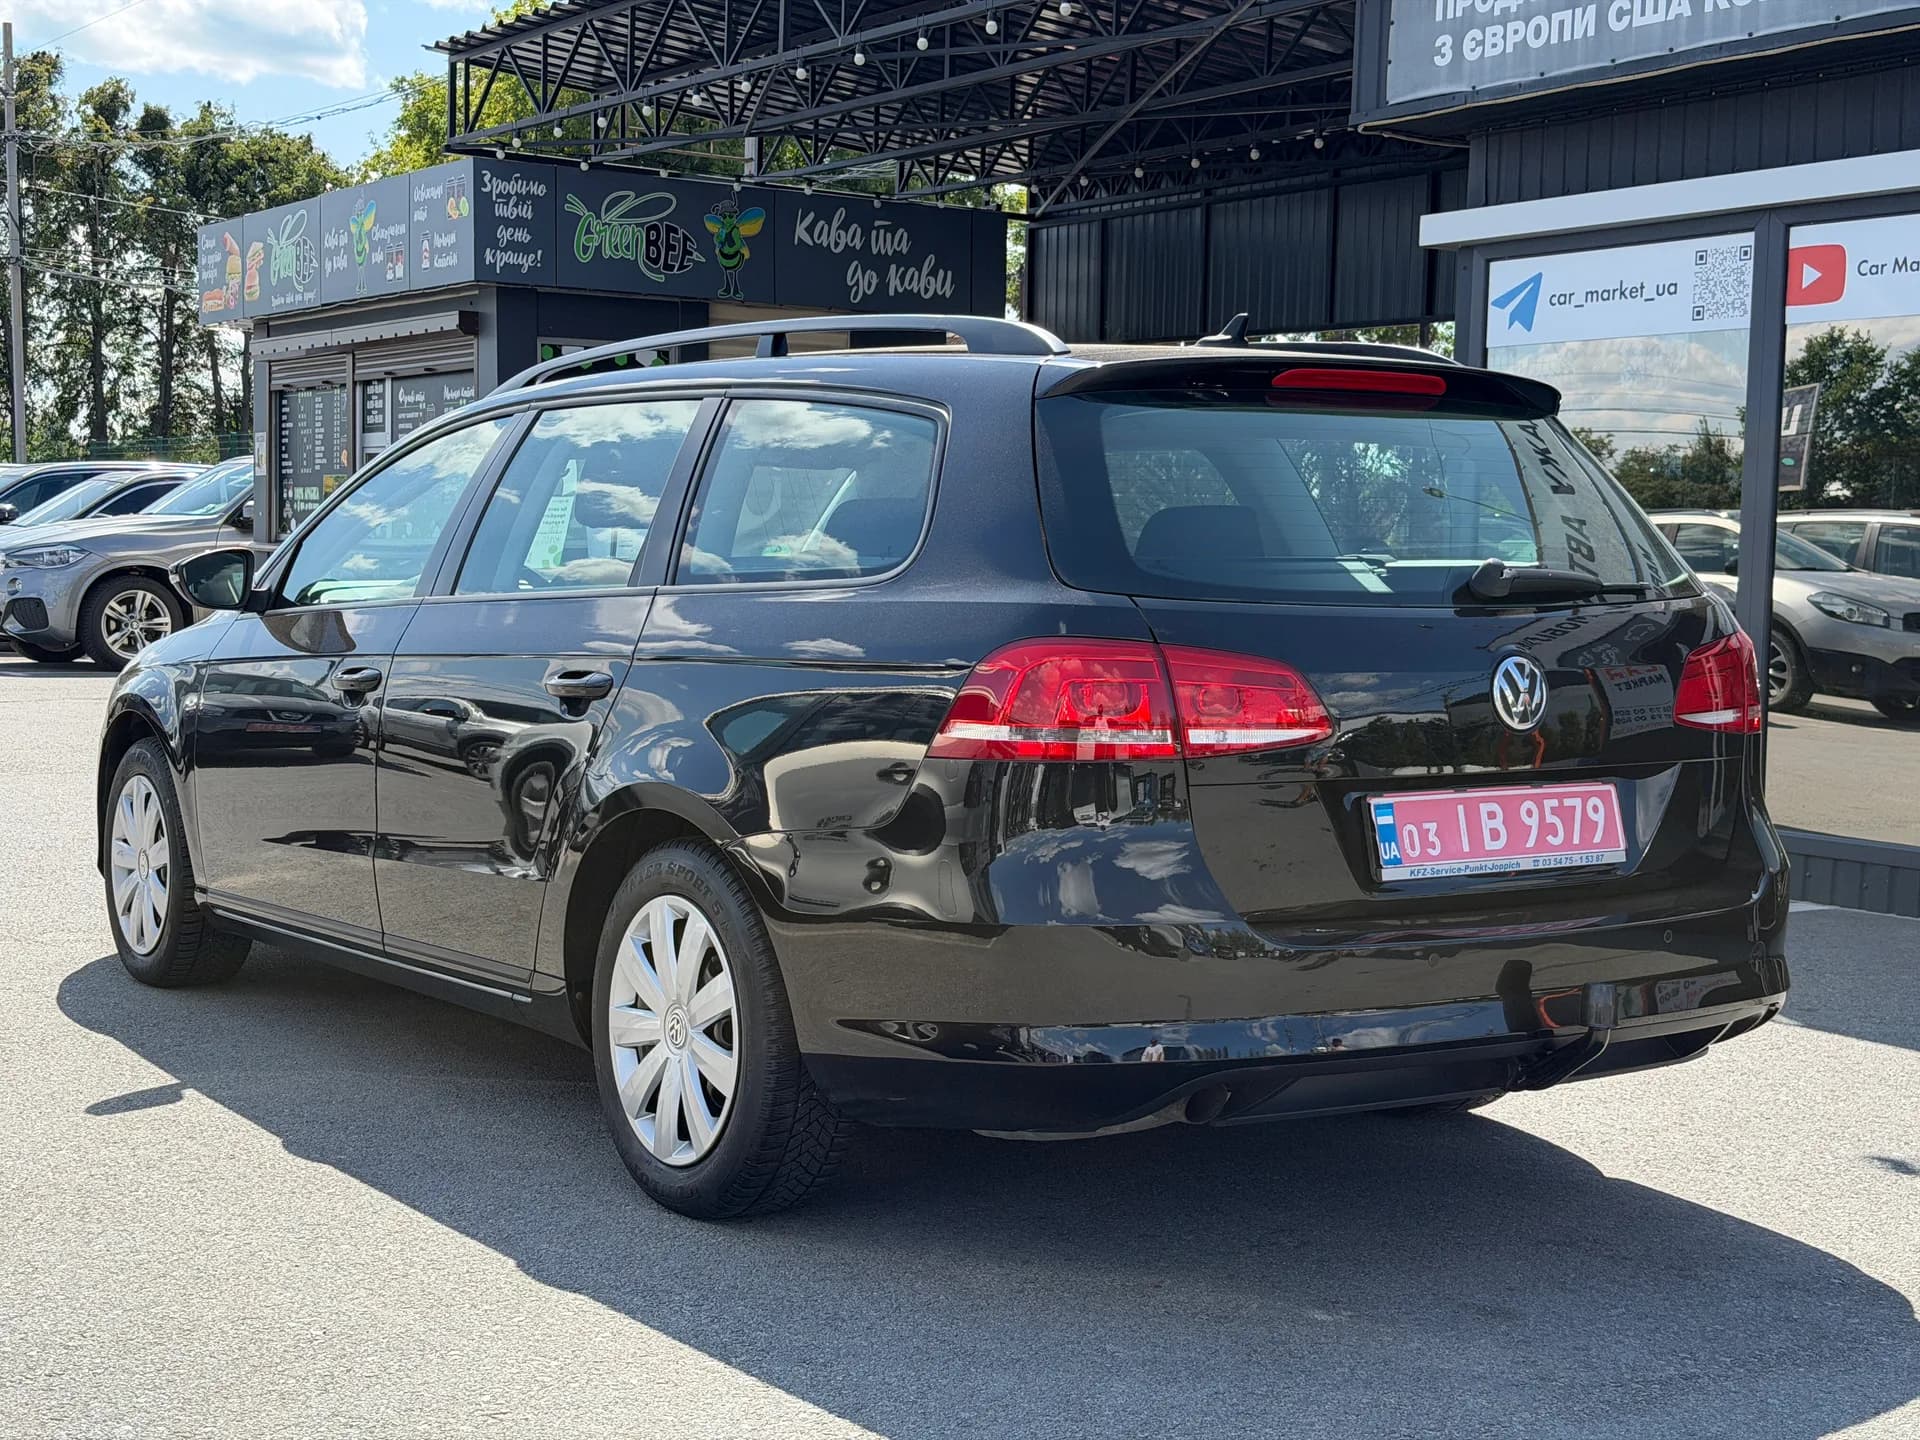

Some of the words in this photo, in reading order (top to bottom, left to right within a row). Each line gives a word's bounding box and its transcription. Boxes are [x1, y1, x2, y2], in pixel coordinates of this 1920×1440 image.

[1434, 35, 1453, 67] З
[1462, 4, 1597, 61] ЄВРОПИ
[1608, 0, 1692, 31] США
[480, 170, 547, 200] Зробимо
[494, 196, 534, 220] твій
[496, 224, 532, 248] день
[794, 207, 864, 254] Кава
[871, 220, 911, 255] та
[484, 247, 543, 274] краще!
[1857, 260, 1888, 277] Car
[847, 260, 878, 304] до
[886, 254, 955, 300] кави
[1549, 280, 1678, 308] car_market_ua
[1402, 822, 1441, 858] 03
[1457, 802, 1507, 853] IB
[1520, 797, 1605, 849] 9579
[1381, 842, 1400, 860] UA
